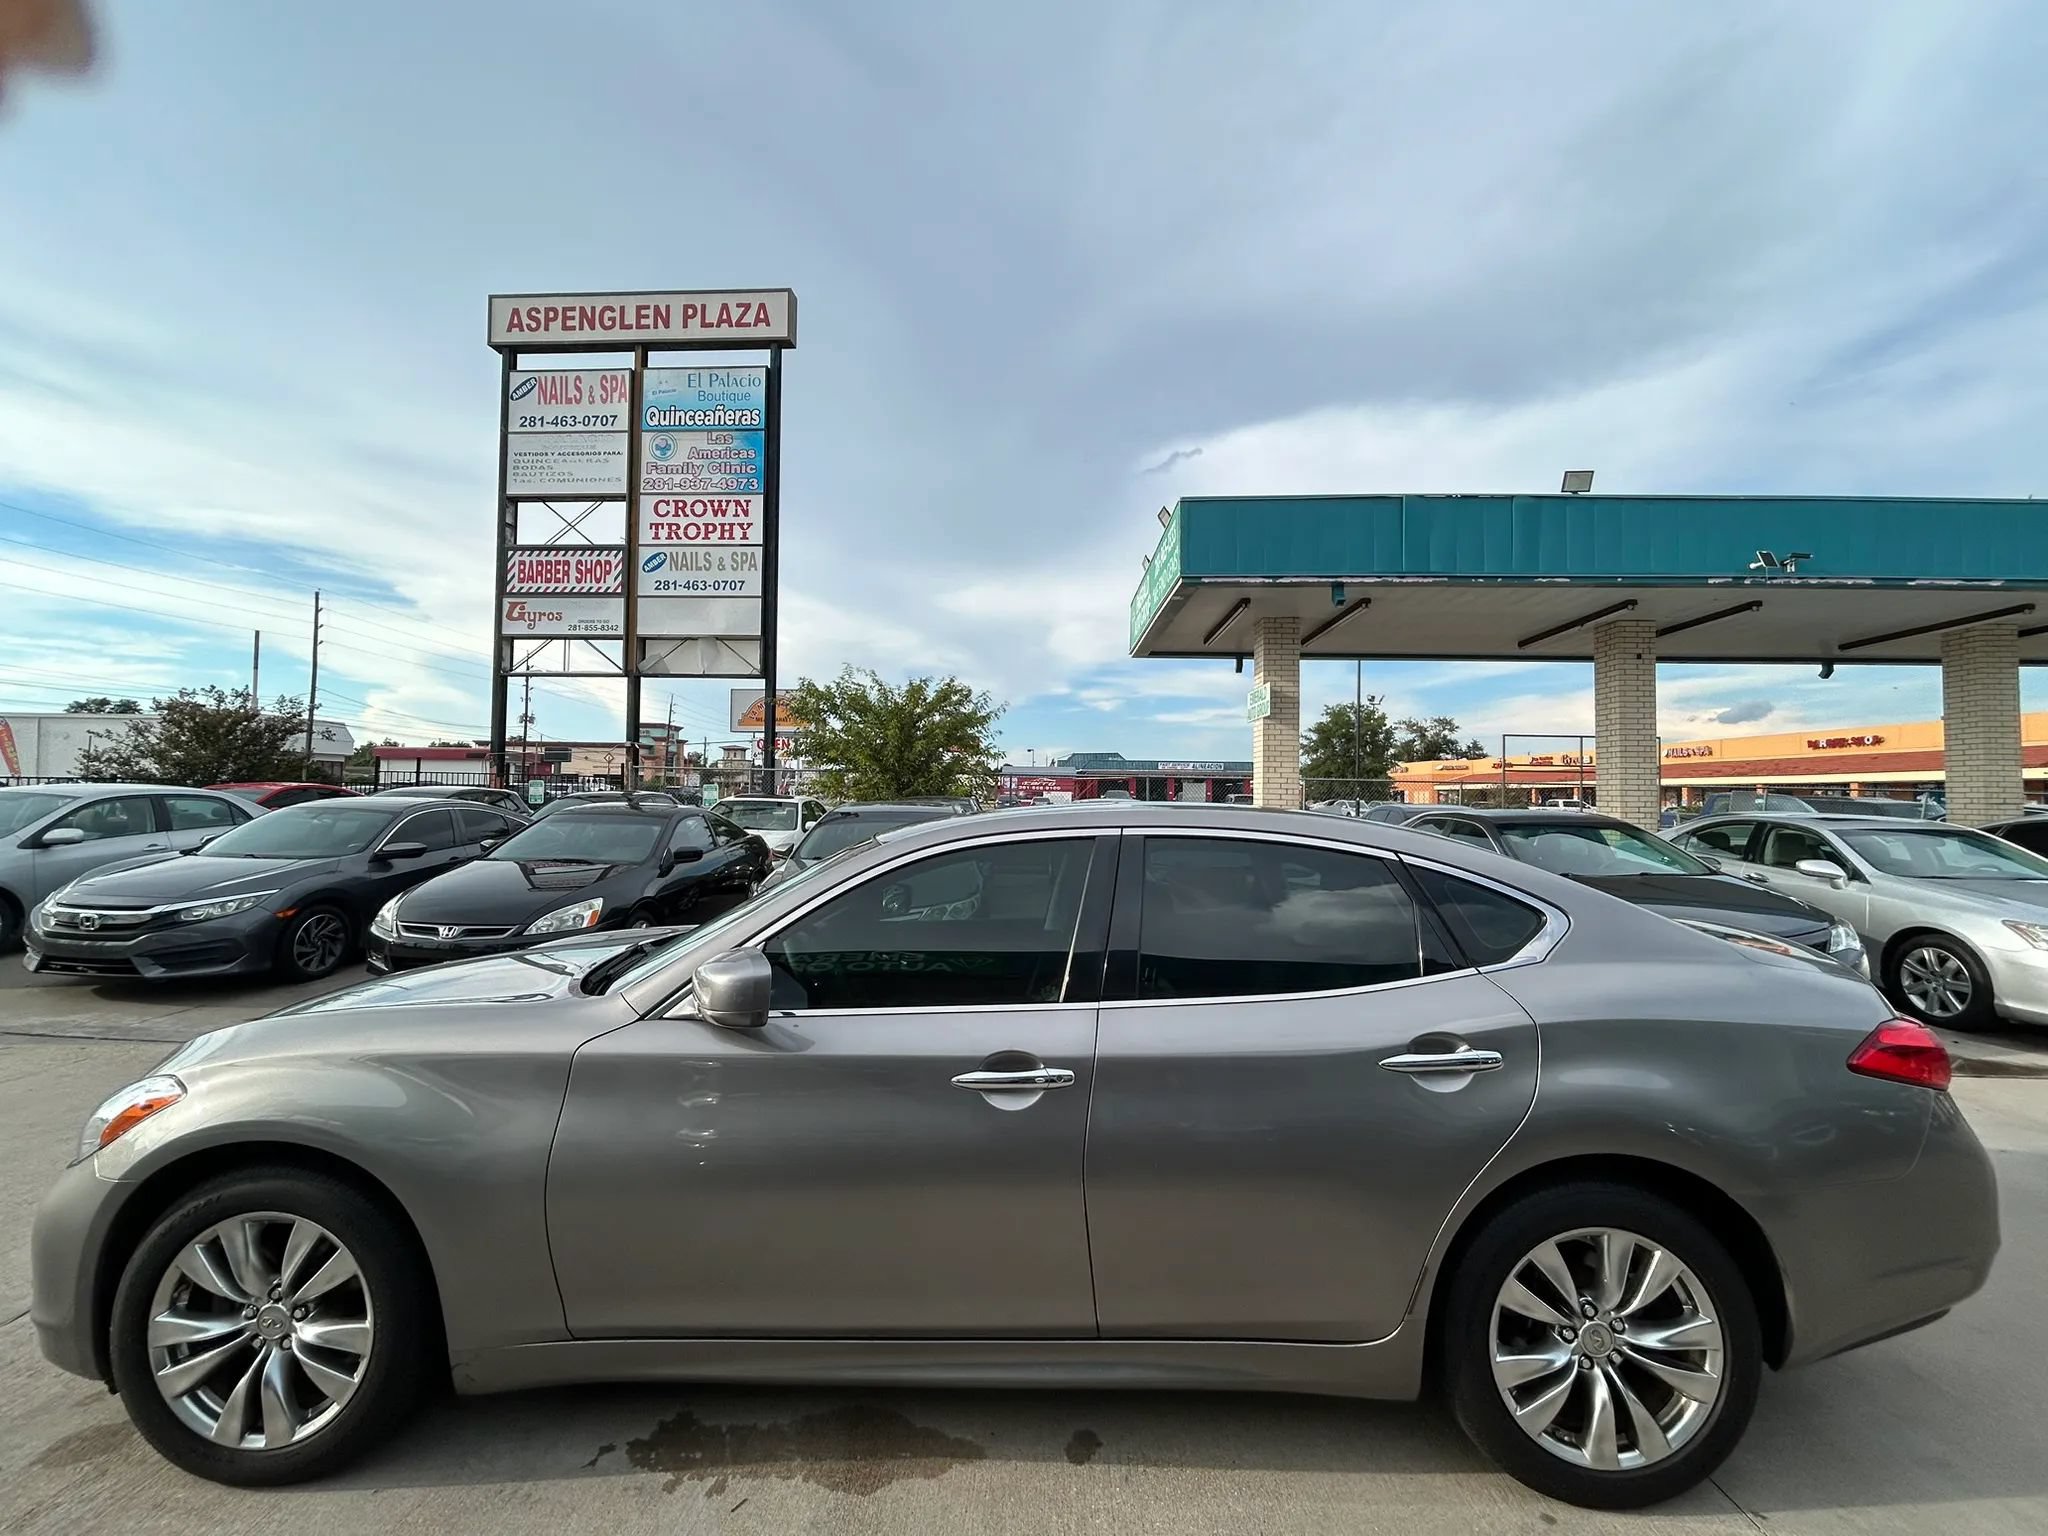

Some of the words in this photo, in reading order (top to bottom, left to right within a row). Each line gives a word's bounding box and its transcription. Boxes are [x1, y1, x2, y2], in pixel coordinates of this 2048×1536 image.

[506, 304, 670, 333] ASPENGLEN
[682, 302, 771, 329] PLAZA
[511, 377, 537, 401] AMBER
[687, 372, 703, 388] El
[537, 374, 582, 405] NAILS
[587, 387, 595, 404] &
[600, 374, 627, 403] SPA
[697, 390, 751, 403] Boutique
[519, 415, 618, 428] 281-463-0707
[645, 405, 760, 428] Quinceañeras
[706, 432, 733, 445] Las
[688, 447, 756, 460] Americas
[646, 462, 704, 478] Family
[708, 462, 757, 475] Clinic
[643, 478, 759, 491] 281-937-4973
[653, 499, 752, 518] CROWN
[649, 522, 754, 540] TROPHY
[642, 552, 667, 573] AMBER
[669, 552, 712, 572] NAILS
[718, 557, 726, 571] &
[731, 551, 758, 571] SPA
[517, 559, 571, 584] BARBER
[575, 559, 612, 584] SHOP
[654, 580, 746, 591] 281-463-0707
[505, 601, 563, 630] Gyros
[757, 738, 790, 750] OEN
